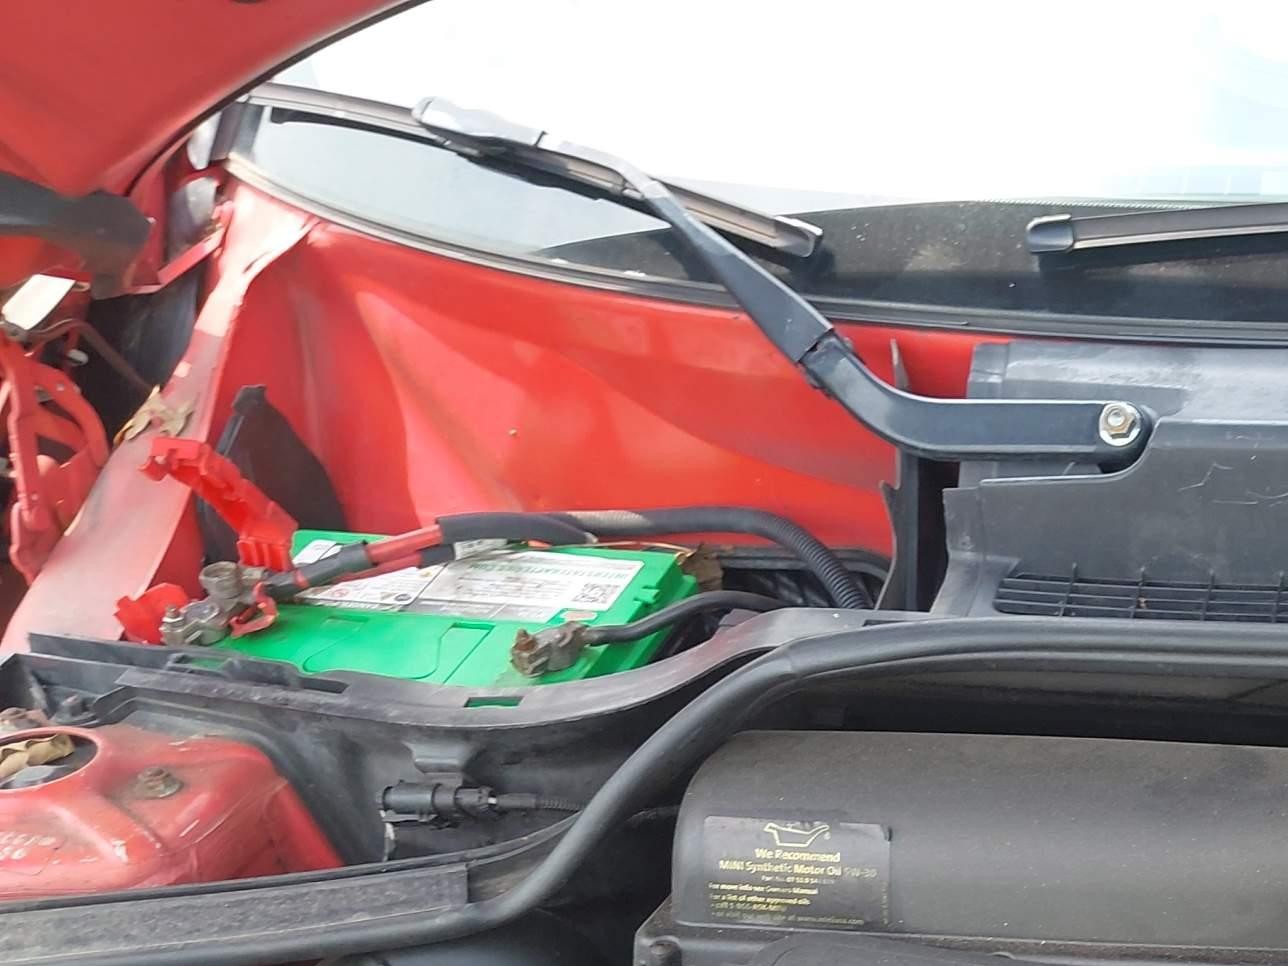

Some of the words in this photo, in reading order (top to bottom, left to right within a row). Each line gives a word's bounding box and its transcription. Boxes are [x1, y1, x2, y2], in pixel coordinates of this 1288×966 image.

[755, 848, 773, 859] We
[774, 849, 841, 863] Recommend
[745, 861, 792, 874] Synthetic
[793, 864, 825, 875] Motor
[826, 865, 842, 876] Oil
